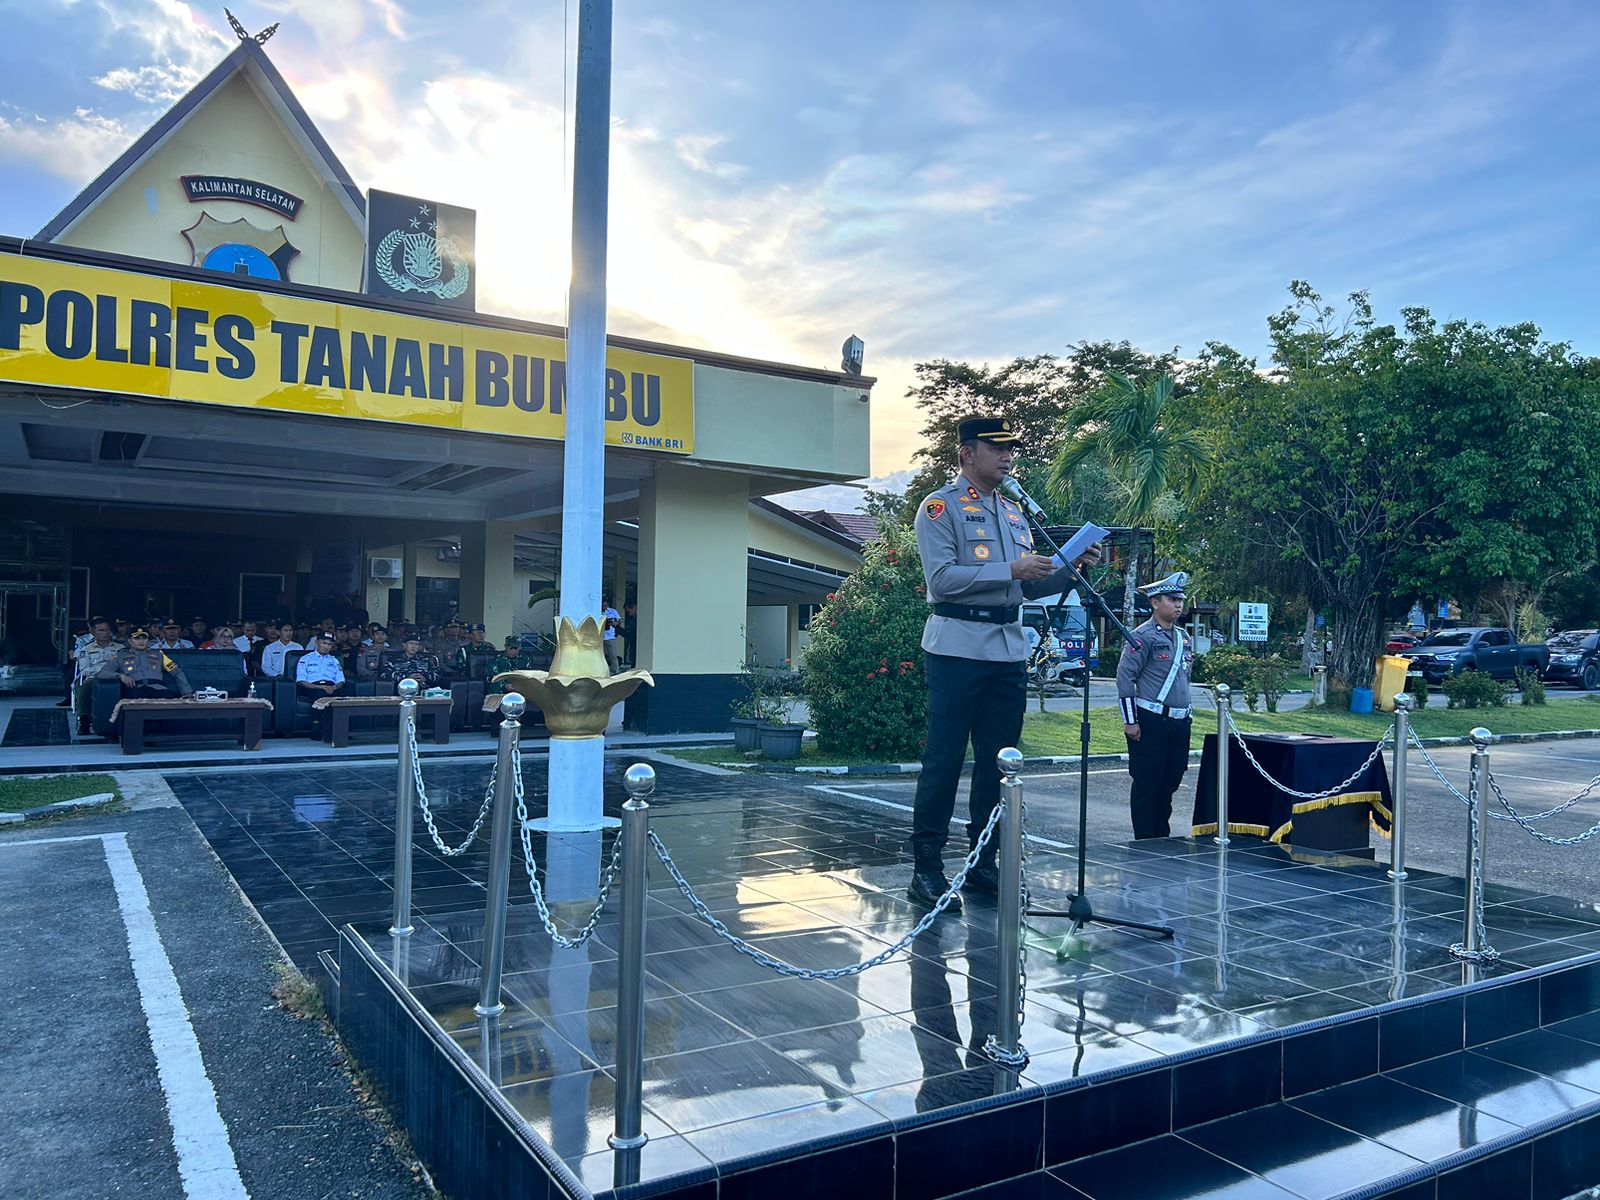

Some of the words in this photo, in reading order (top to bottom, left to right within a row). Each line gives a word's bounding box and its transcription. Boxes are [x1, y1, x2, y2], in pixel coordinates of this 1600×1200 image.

[190, 181, 252, 196] KALIMANTAN
[254, 188, 295, 210] SELATAN
[0, 280, 256, 380] POLRES
[271, 320, 464, 402] TANAH
[635, 435, 662, 447] BANK
[665, 438, 683, 449] BRI
[1060, 641, 1094, 649] POLII
